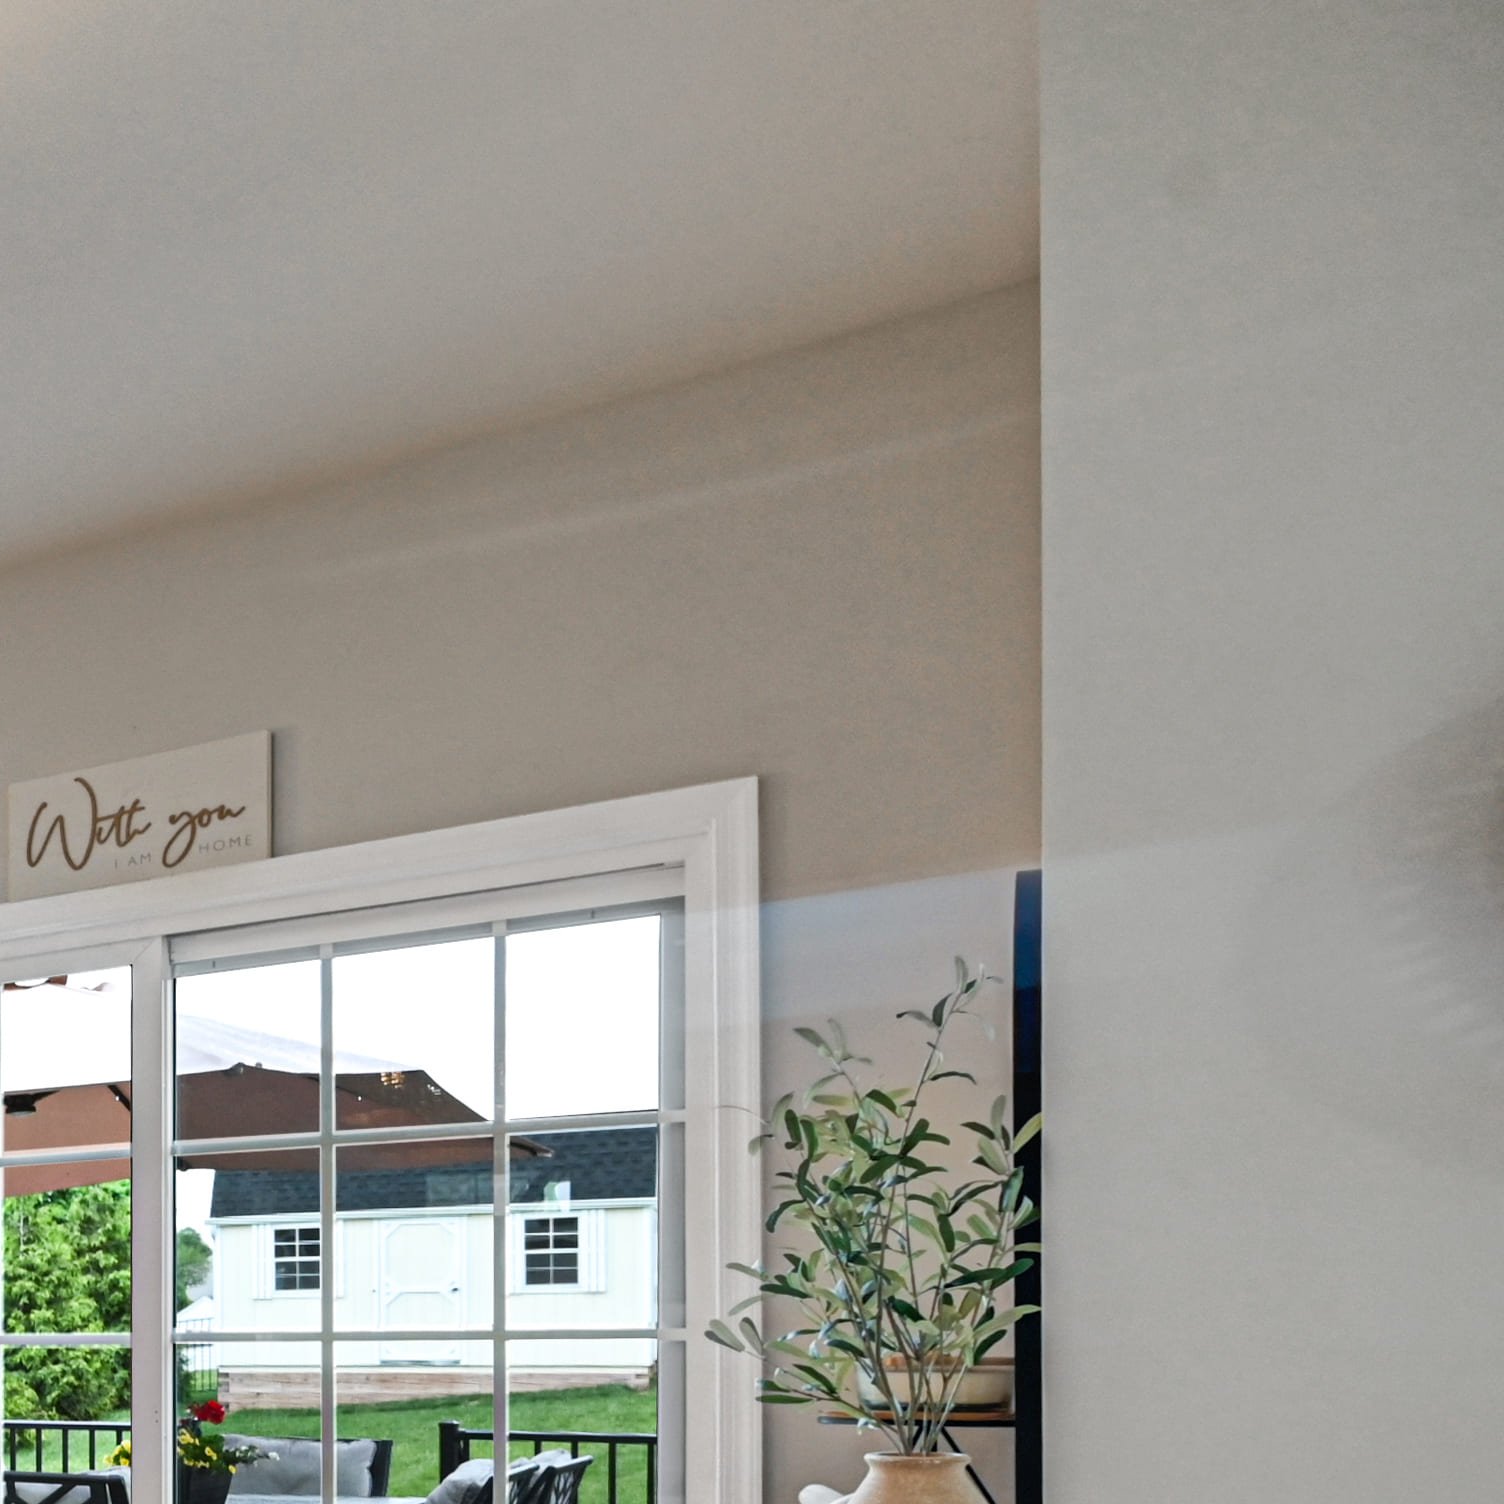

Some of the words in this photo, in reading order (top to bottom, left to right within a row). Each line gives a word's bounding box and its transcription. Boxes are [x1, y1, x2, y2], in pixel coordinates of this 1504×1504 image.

[127, 852, 152, 866] AM
[198, 834, 254, 854] HOME
[161, 804, 246, 868] you
